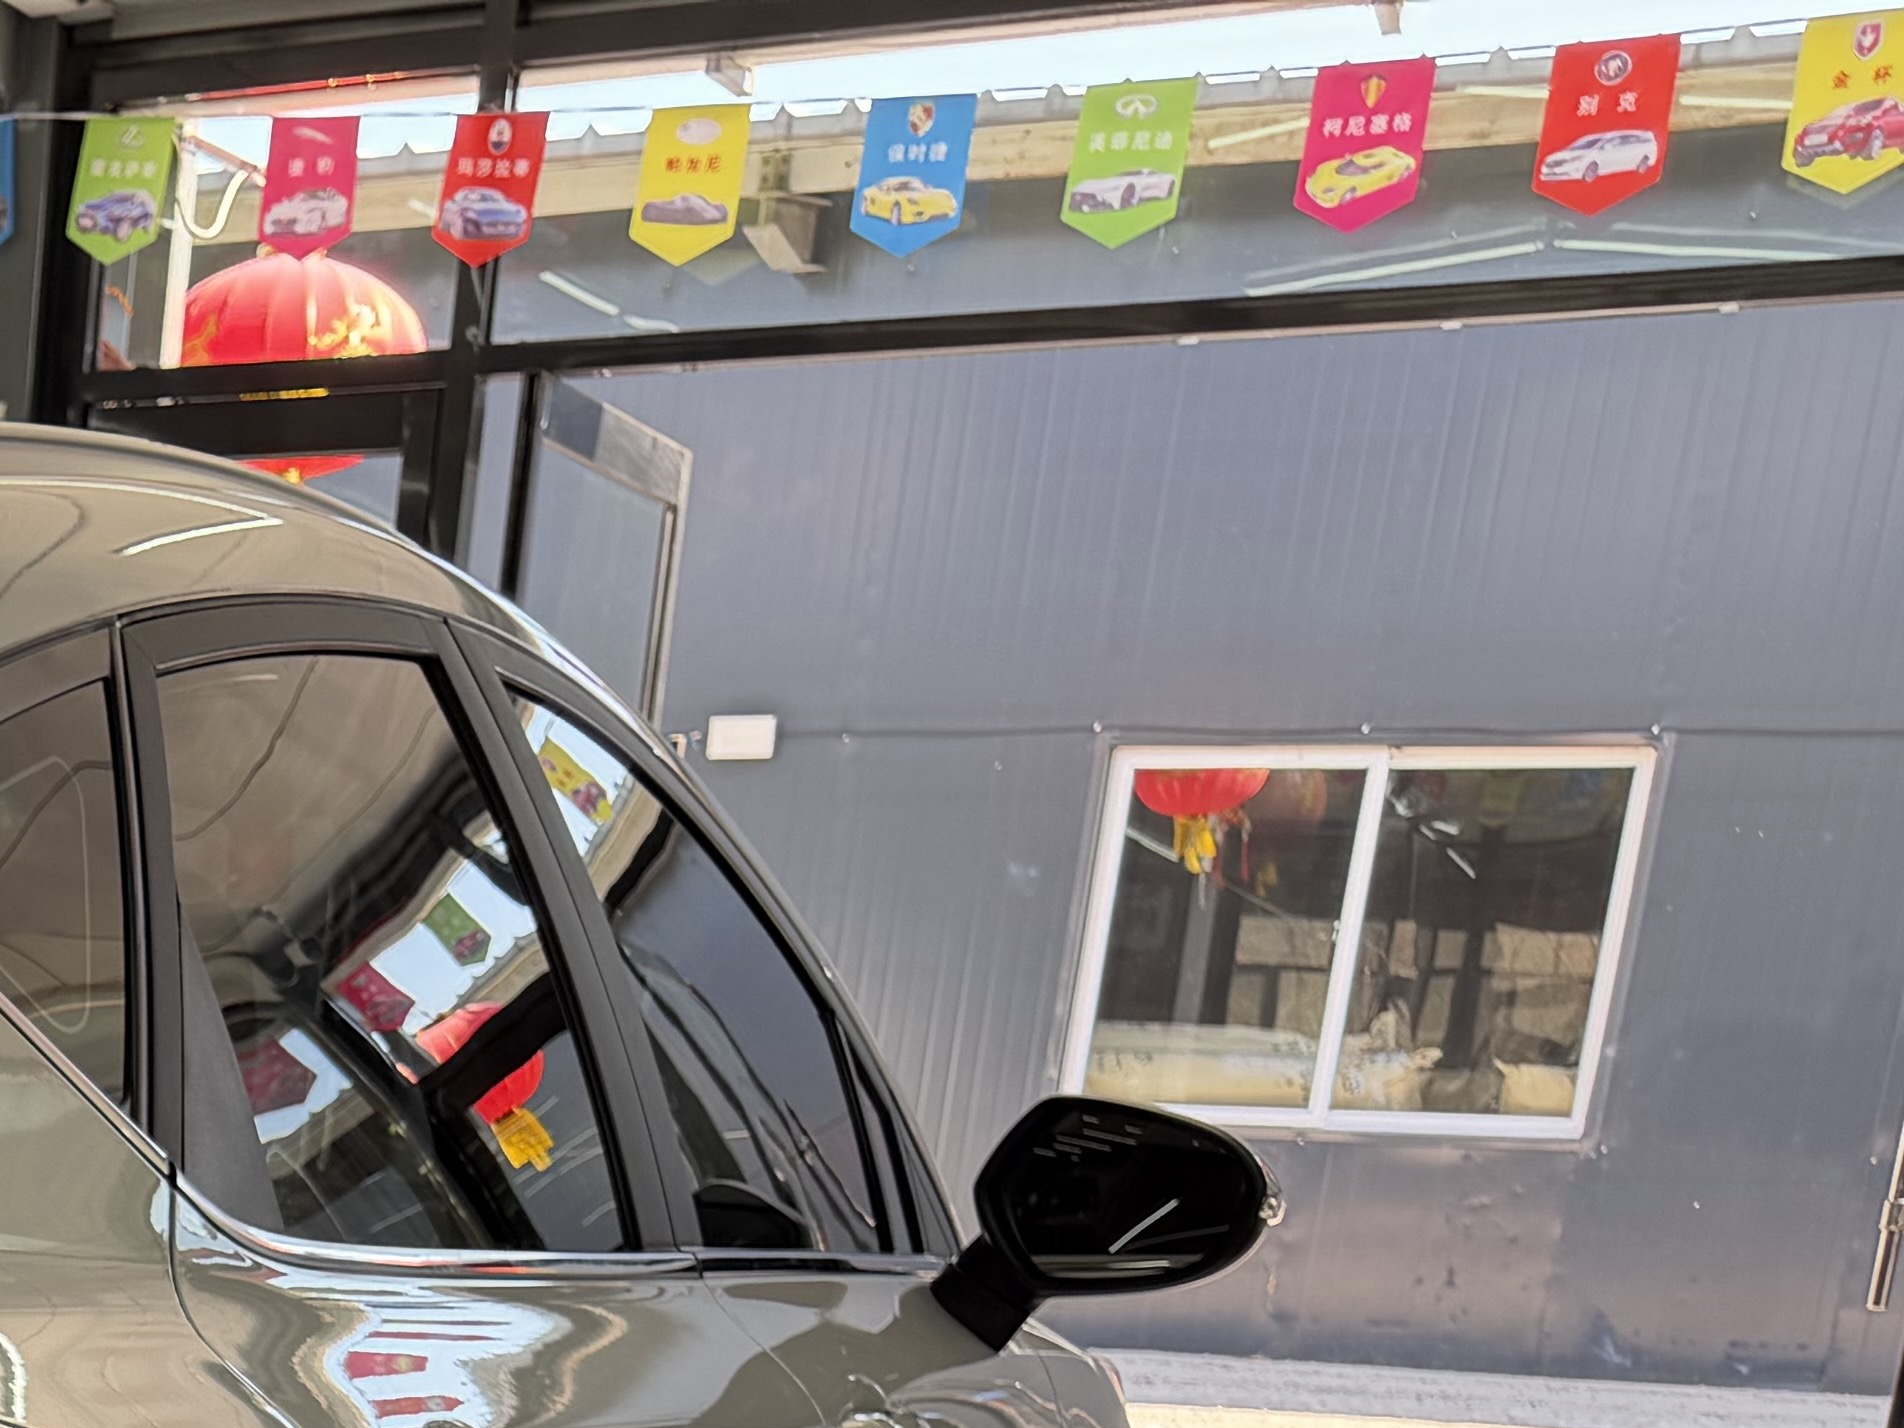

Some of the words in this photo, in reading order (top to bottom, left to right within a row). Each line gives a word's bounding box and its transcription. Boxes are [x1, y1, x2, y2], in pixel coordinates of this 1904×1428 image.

[1576, 91, 1639, 117] 别克
[1322, 111, 1412, 138] 柯尼塞格
[455, 157, 531, 178] 玛莎拉蒂
